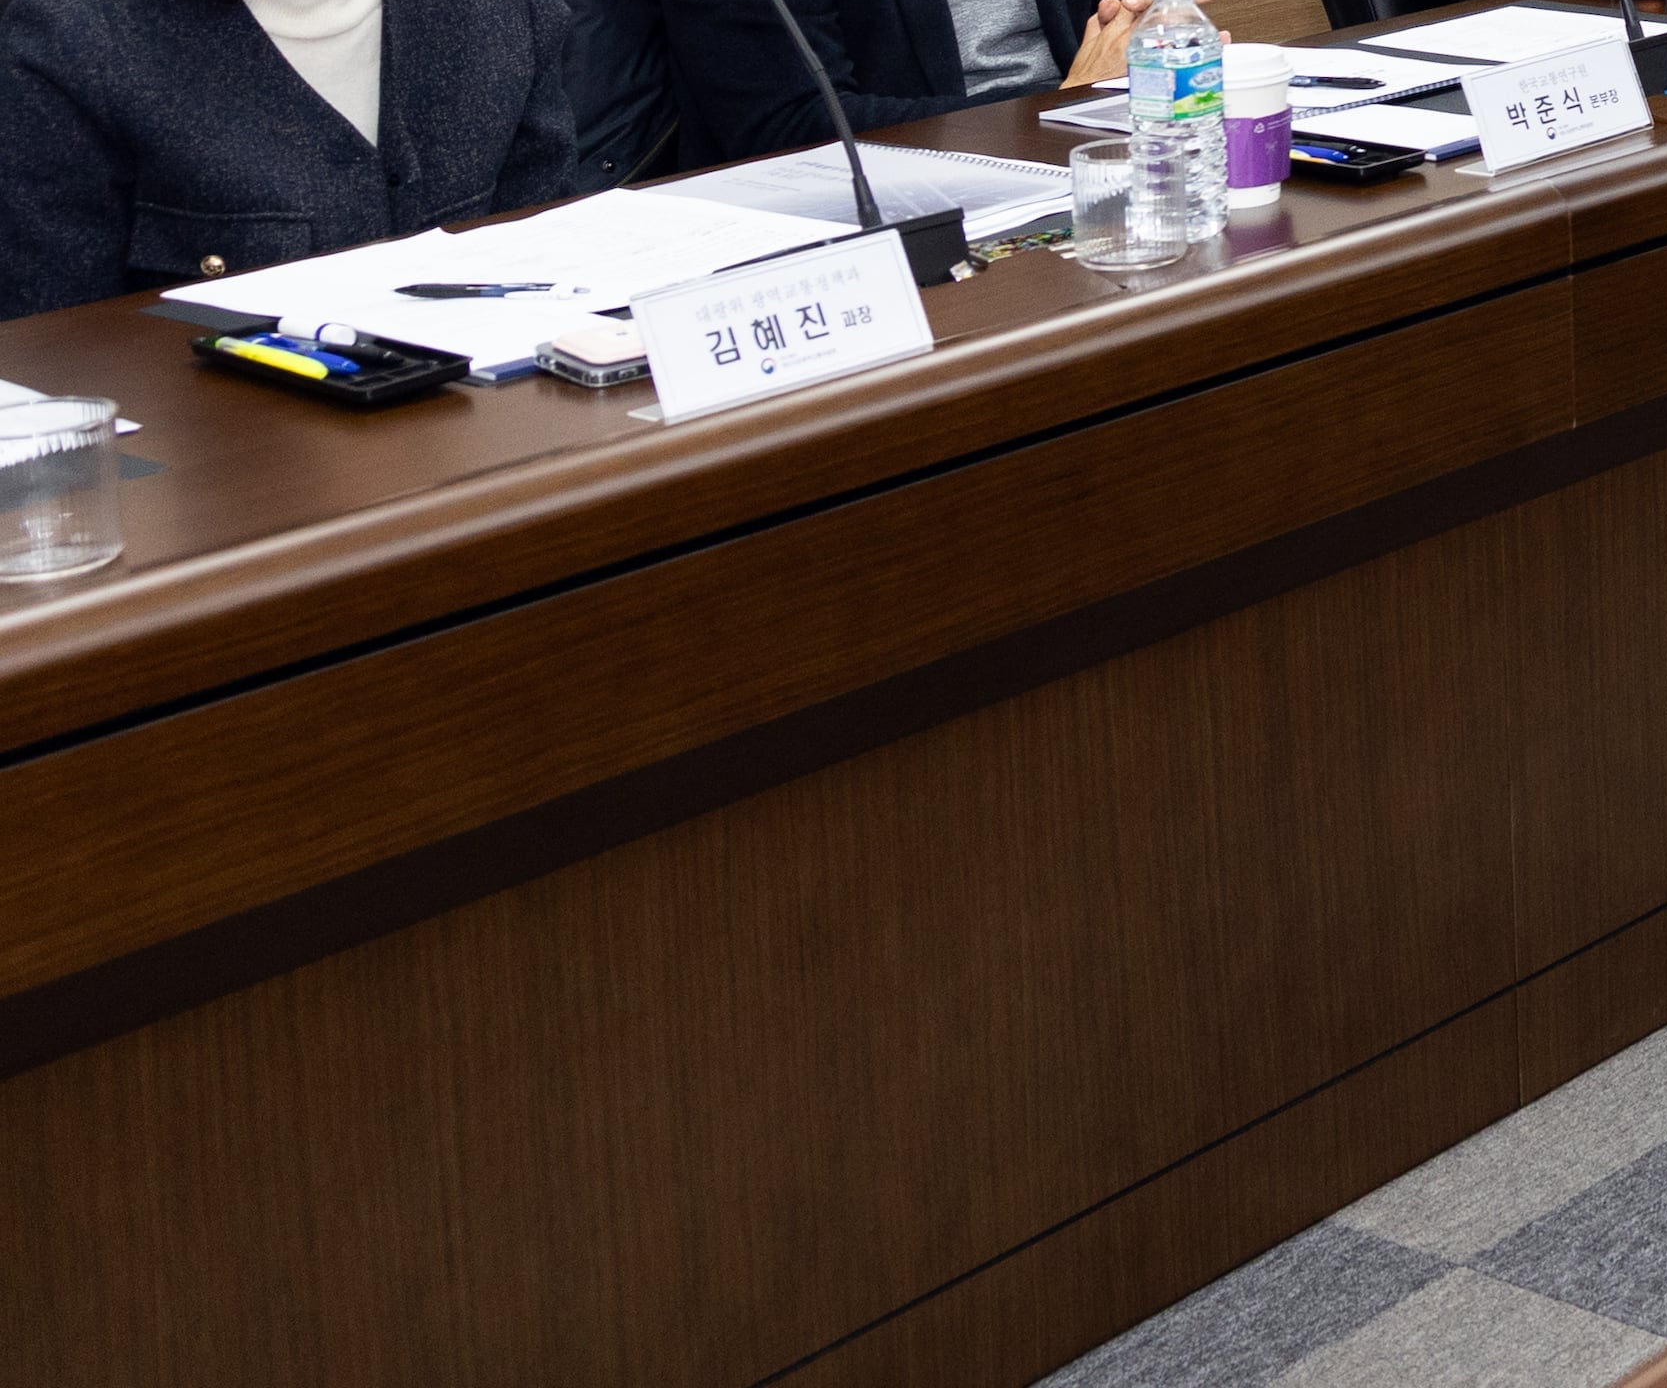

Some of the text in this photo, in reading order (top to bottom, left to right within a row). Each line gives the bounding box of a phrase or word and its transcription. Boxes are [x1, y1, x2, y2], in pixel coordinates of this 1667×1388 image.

[1506, 86, 1584, 131] 박준식
[1589, 89, 1620, 109] 본부장
[705, 302, 830, 366] 김혜진
[841, 305, 873, 329] 과장
